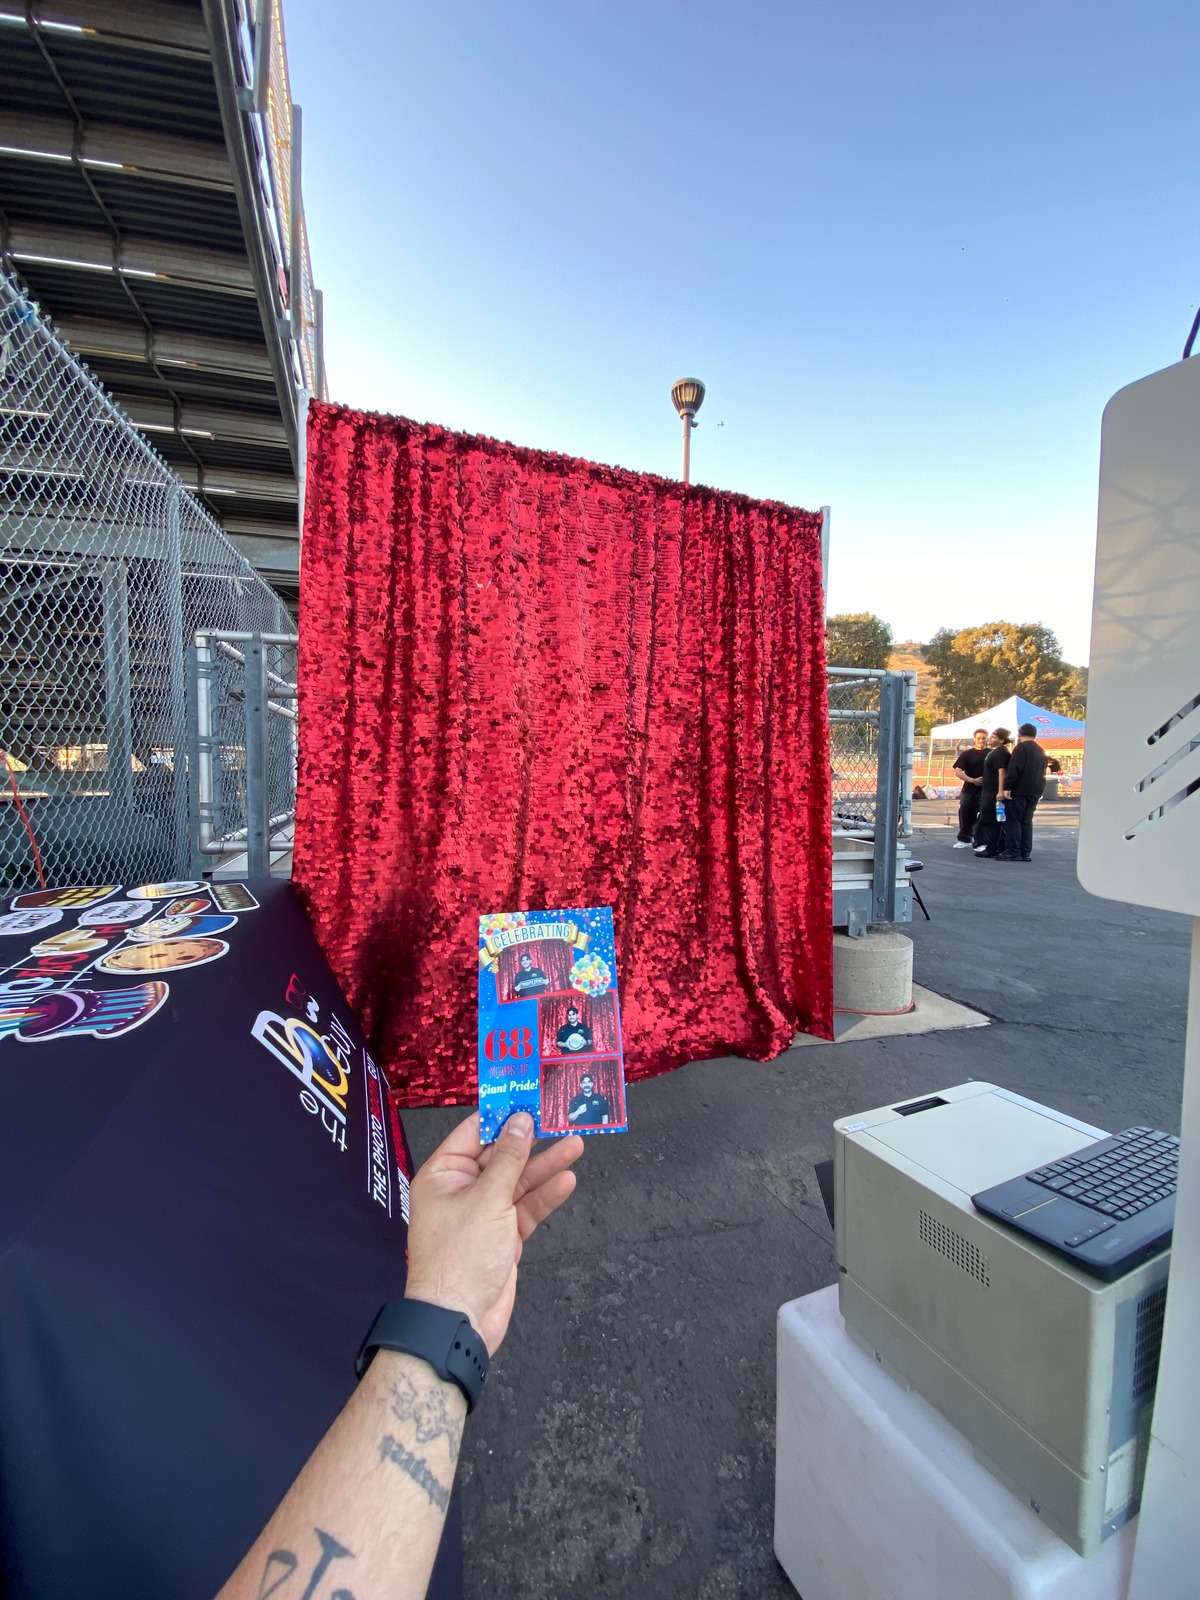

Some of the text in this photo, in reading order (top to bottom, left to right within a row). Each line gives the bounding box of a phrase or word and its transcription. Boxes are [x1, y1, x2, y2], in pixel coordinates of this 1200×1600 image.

[493, 924, 571, 949] CELEBRATING
[484, 1026, 533, 1062] 68
[490, 1063, 529, 1078] YEARS OF
[479, 1078, 539, 1098] Giant Pride!
[373, 1164, 387, 1208] THE
